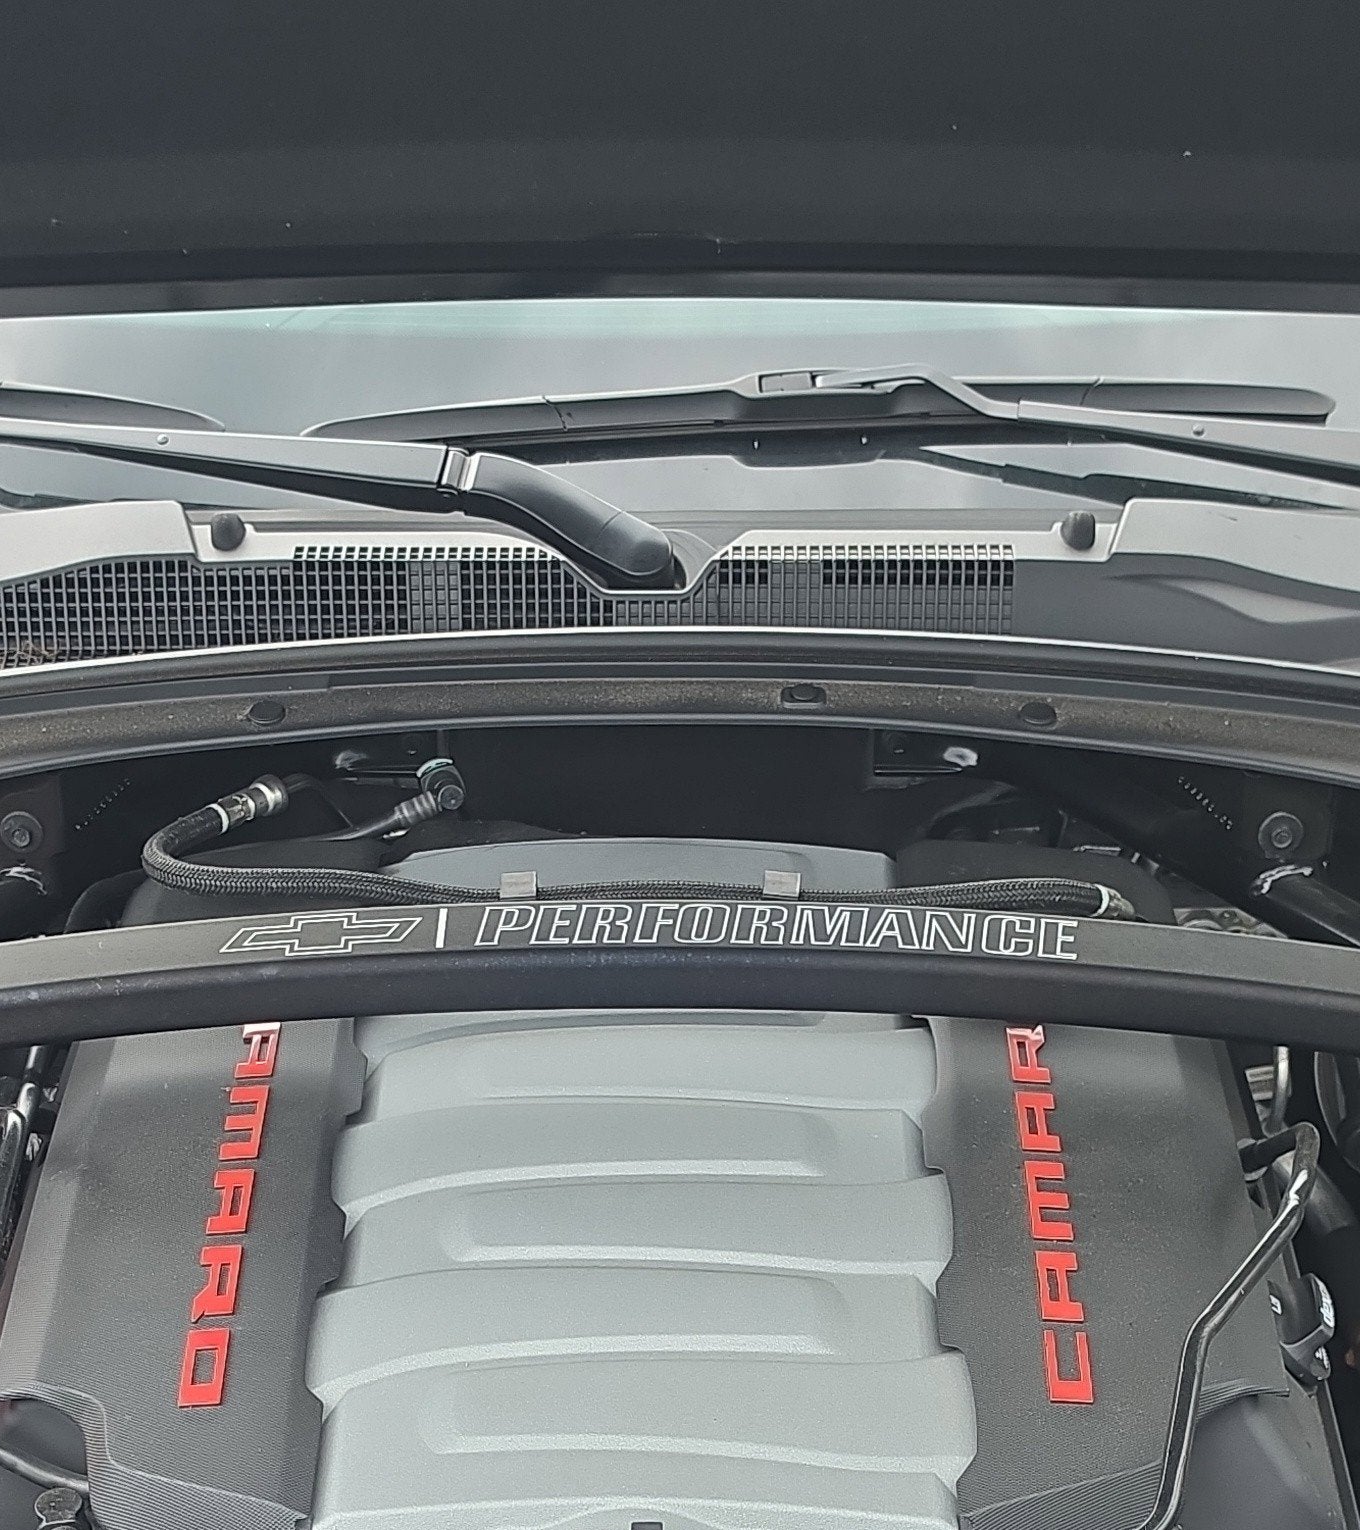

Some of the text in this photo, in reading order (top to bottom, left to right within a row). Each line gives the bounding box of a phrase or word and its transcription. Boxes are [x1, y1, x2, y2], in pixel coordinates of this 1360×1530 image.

[473, 902, 1078, 961] PERFORMANCE
[177, 1022, 281, 1409] AMARO
[1005, 1024, 1095, 1405] CAMAR
